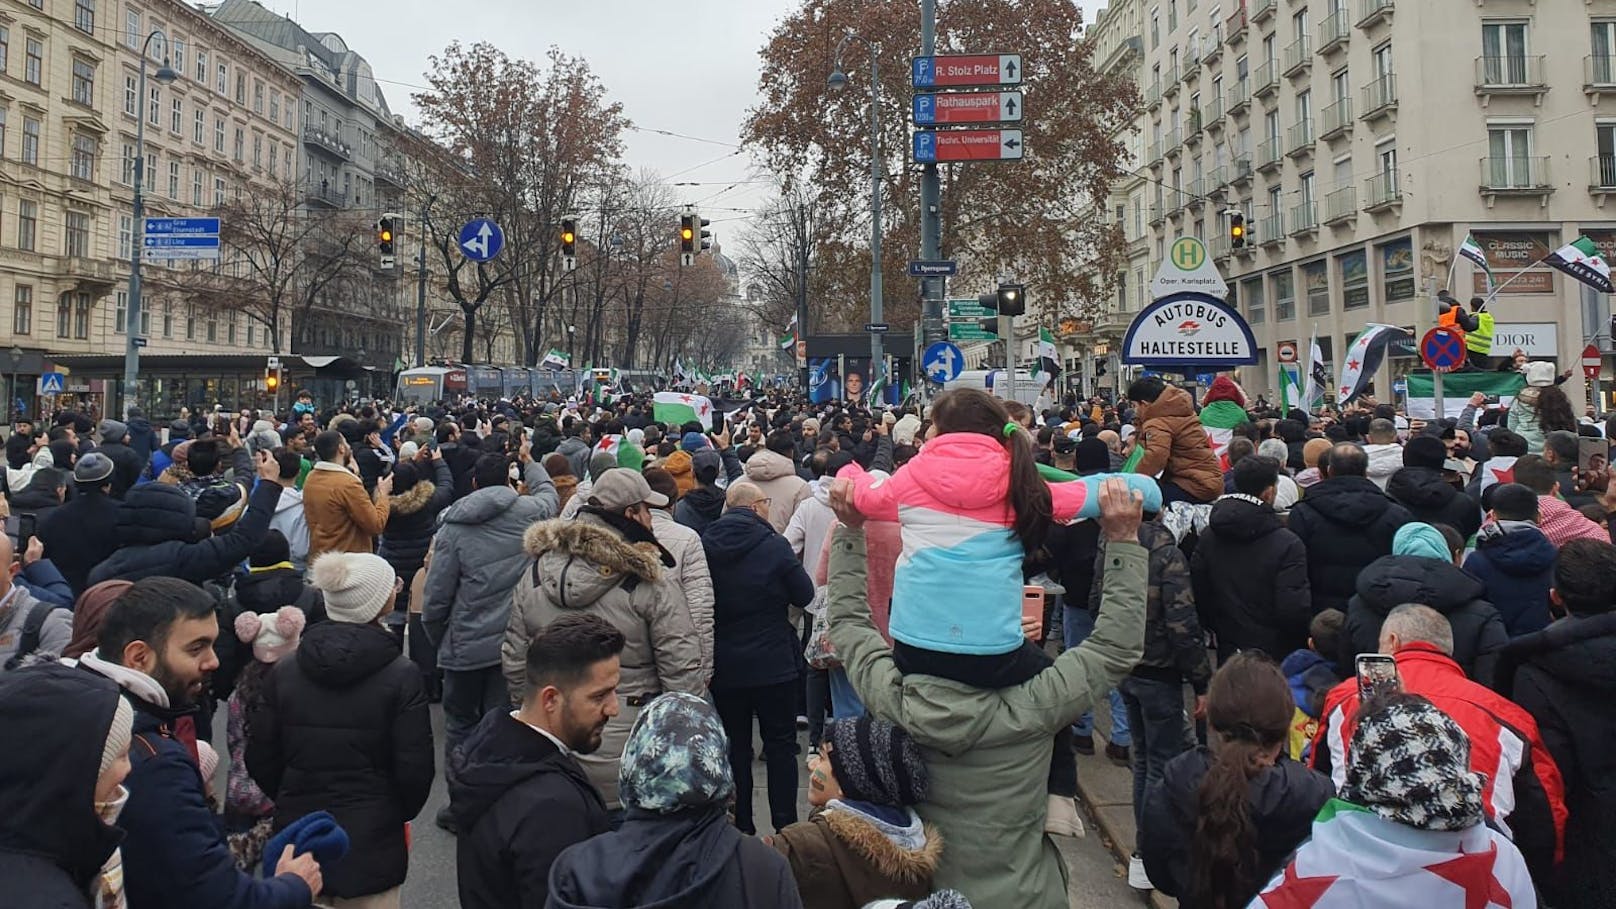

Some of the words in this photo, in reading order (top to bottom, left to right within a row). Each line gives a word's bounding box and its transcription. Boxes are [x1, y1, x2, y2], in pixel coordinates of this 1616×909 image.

[936, 67, 946, 76] R.
[948, 66, 972, 76] Stolz
[974, 65, 998, 76] Platz
[936, 95, 998, 108] Rathauspark
[937, 136, 960, 145] Techn.
[961, 135, 1000, 145] Universität
[1488, 241, 1534, 250] CLASSIC
[1180, 242, 1197, 265] H
[1495, 250, 1529, 259] MUSIC
[1182, 277, 1217, 286] Karlsplatz
[1585, 272, 1608, 288] SYRIA
[1155, 304, 1227, 328] AUTOBUS
[1496, 334, 1536, 346] DIOR
[1141, 341, 1239, 355] HALTESTELLE
